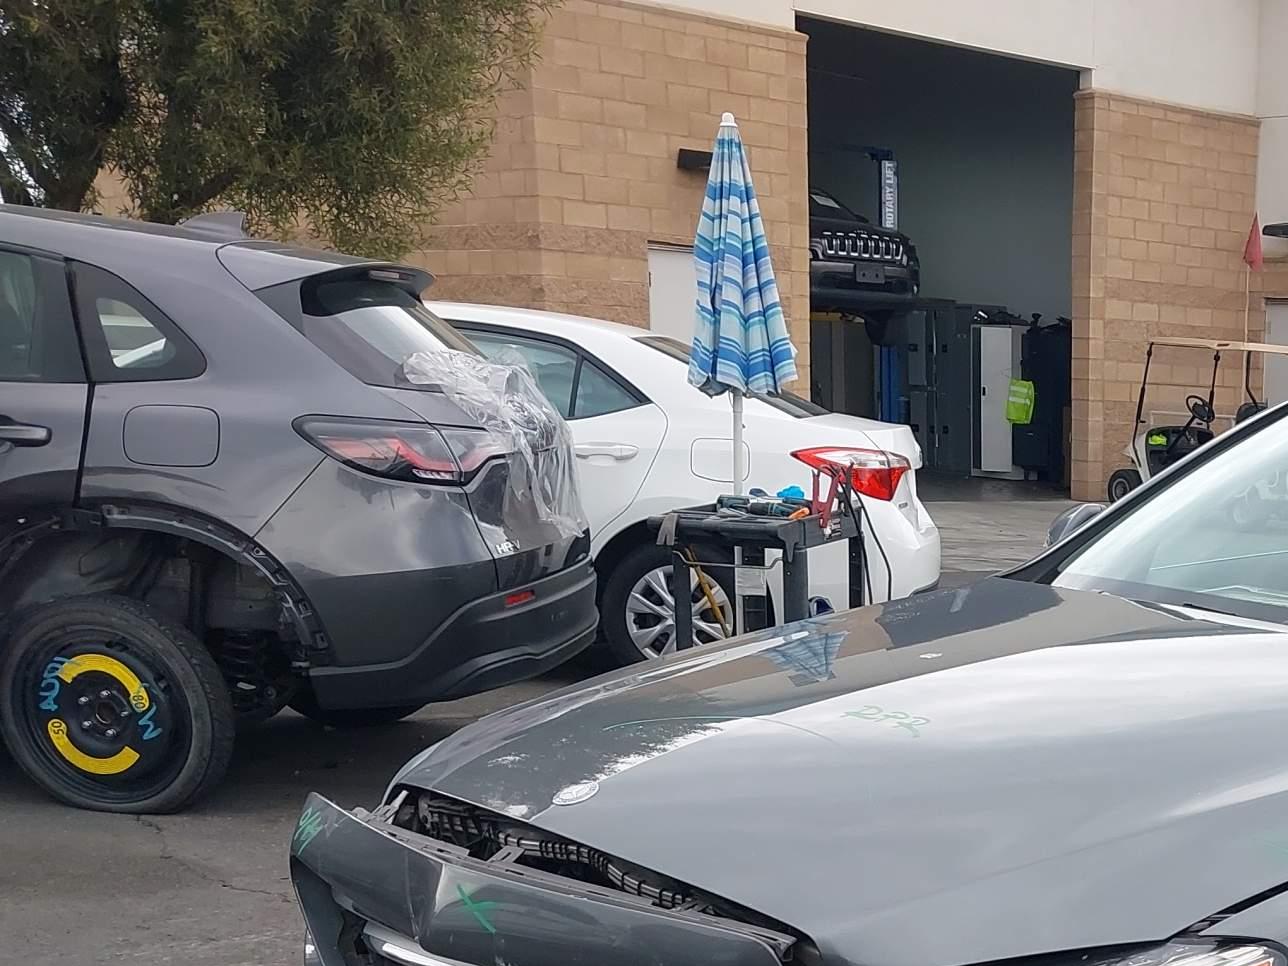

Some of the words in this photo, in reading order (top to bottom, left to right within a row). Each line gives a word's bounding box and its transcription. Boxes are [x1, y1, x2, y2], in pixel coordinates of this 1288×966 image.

[885, 160, 895, 184] LIFT
[885, 185, 895, 229] ROTARY
[131, 693, 147, 710] 80
[50, 720, 64, 736] 50
